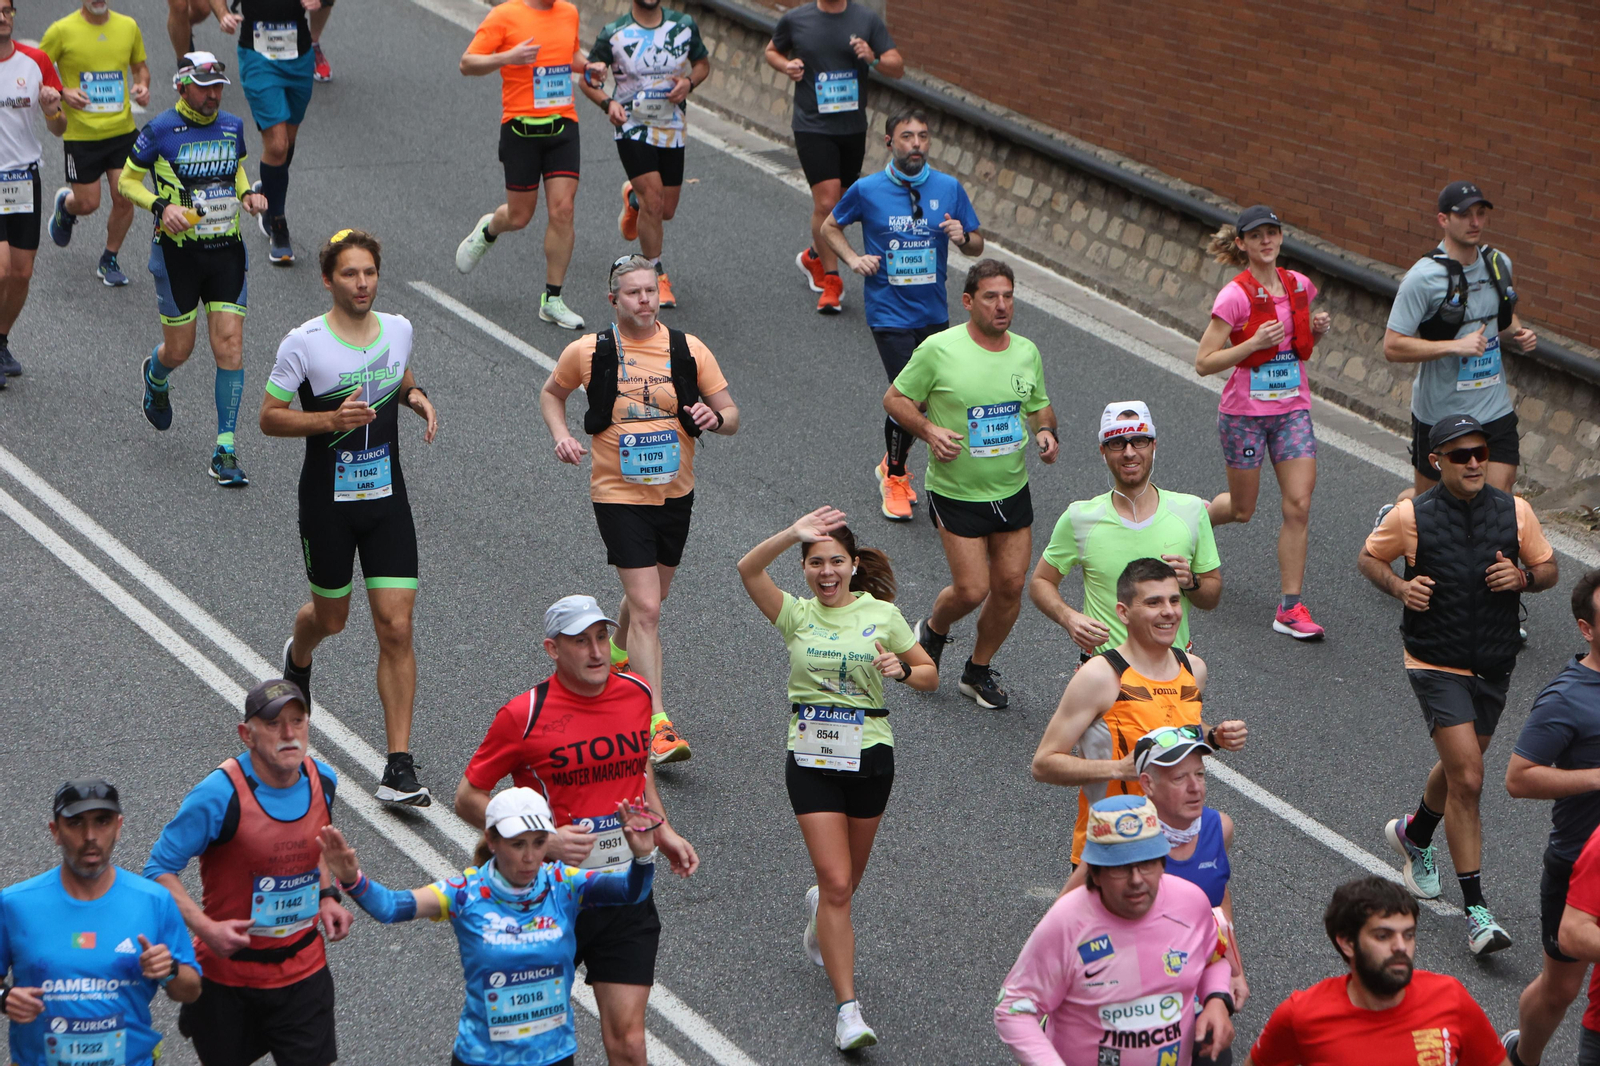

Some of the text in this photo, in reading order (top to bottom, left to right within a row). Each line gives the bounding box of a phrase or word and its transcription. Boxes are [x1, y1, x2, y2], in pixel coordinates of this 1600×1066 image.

[549, 66, 570, 75] ZURICH
[830, 72, 853, 80] ZURICH
[3, 173, 28, 181] ZURICH
[902, 240, 930, 249] ZURICH
[900, 255, 923, 264] 10953
[1268, 369, 1289, 378] 11906
[986, 423, 1009, 433] 11489
[640, 433, 672, 444] ZURICH
[982, 435, 1013, 446] VASILEIOS
[356, 448, 386, 461] ZURICH
[638, 451, 664, 462] 11079
[354, 467, 378, 478] 11042
[640, 466, 663, 474] PIETER
[357, 481, 375, 489] LARS
[806, 647, 875, 662] Maratón Sevilla
[819, 709, 857, 721] ZURICH
[816, 729, 840, 741] 8544
[549, 730, 649, 769] STONE
[821, 746, 834, 755] Tils
[551, 767, 590, 787] MASTER
[273, 839, 308, 852] STONE
[600, 836, 622, 851] 9931
[268, 852, 310, 864] MASTER
[606, 855, 620, 865] Jim
[279, 873, 315, 889] ZURICH
[275, 896, 303, 911] 11442
[275, 914, 299, 925] STEVE
[482, 928, 564, 946] MARATHON
[1090, 938, 1109, 953] NV
[511, 967, 555, 984] ZURICH
[42, 978, 120, 993] GAMEIRO
[510, 991, 544, 1007] 12018
[491, 1003, 565, 1026] CARMEN MATEOS
[72, 1018, 118, 1032] ZURICH
[1099, 1023, 1182, 1049] SIMACEK
[69, 1043, 104, 1055] 11232
